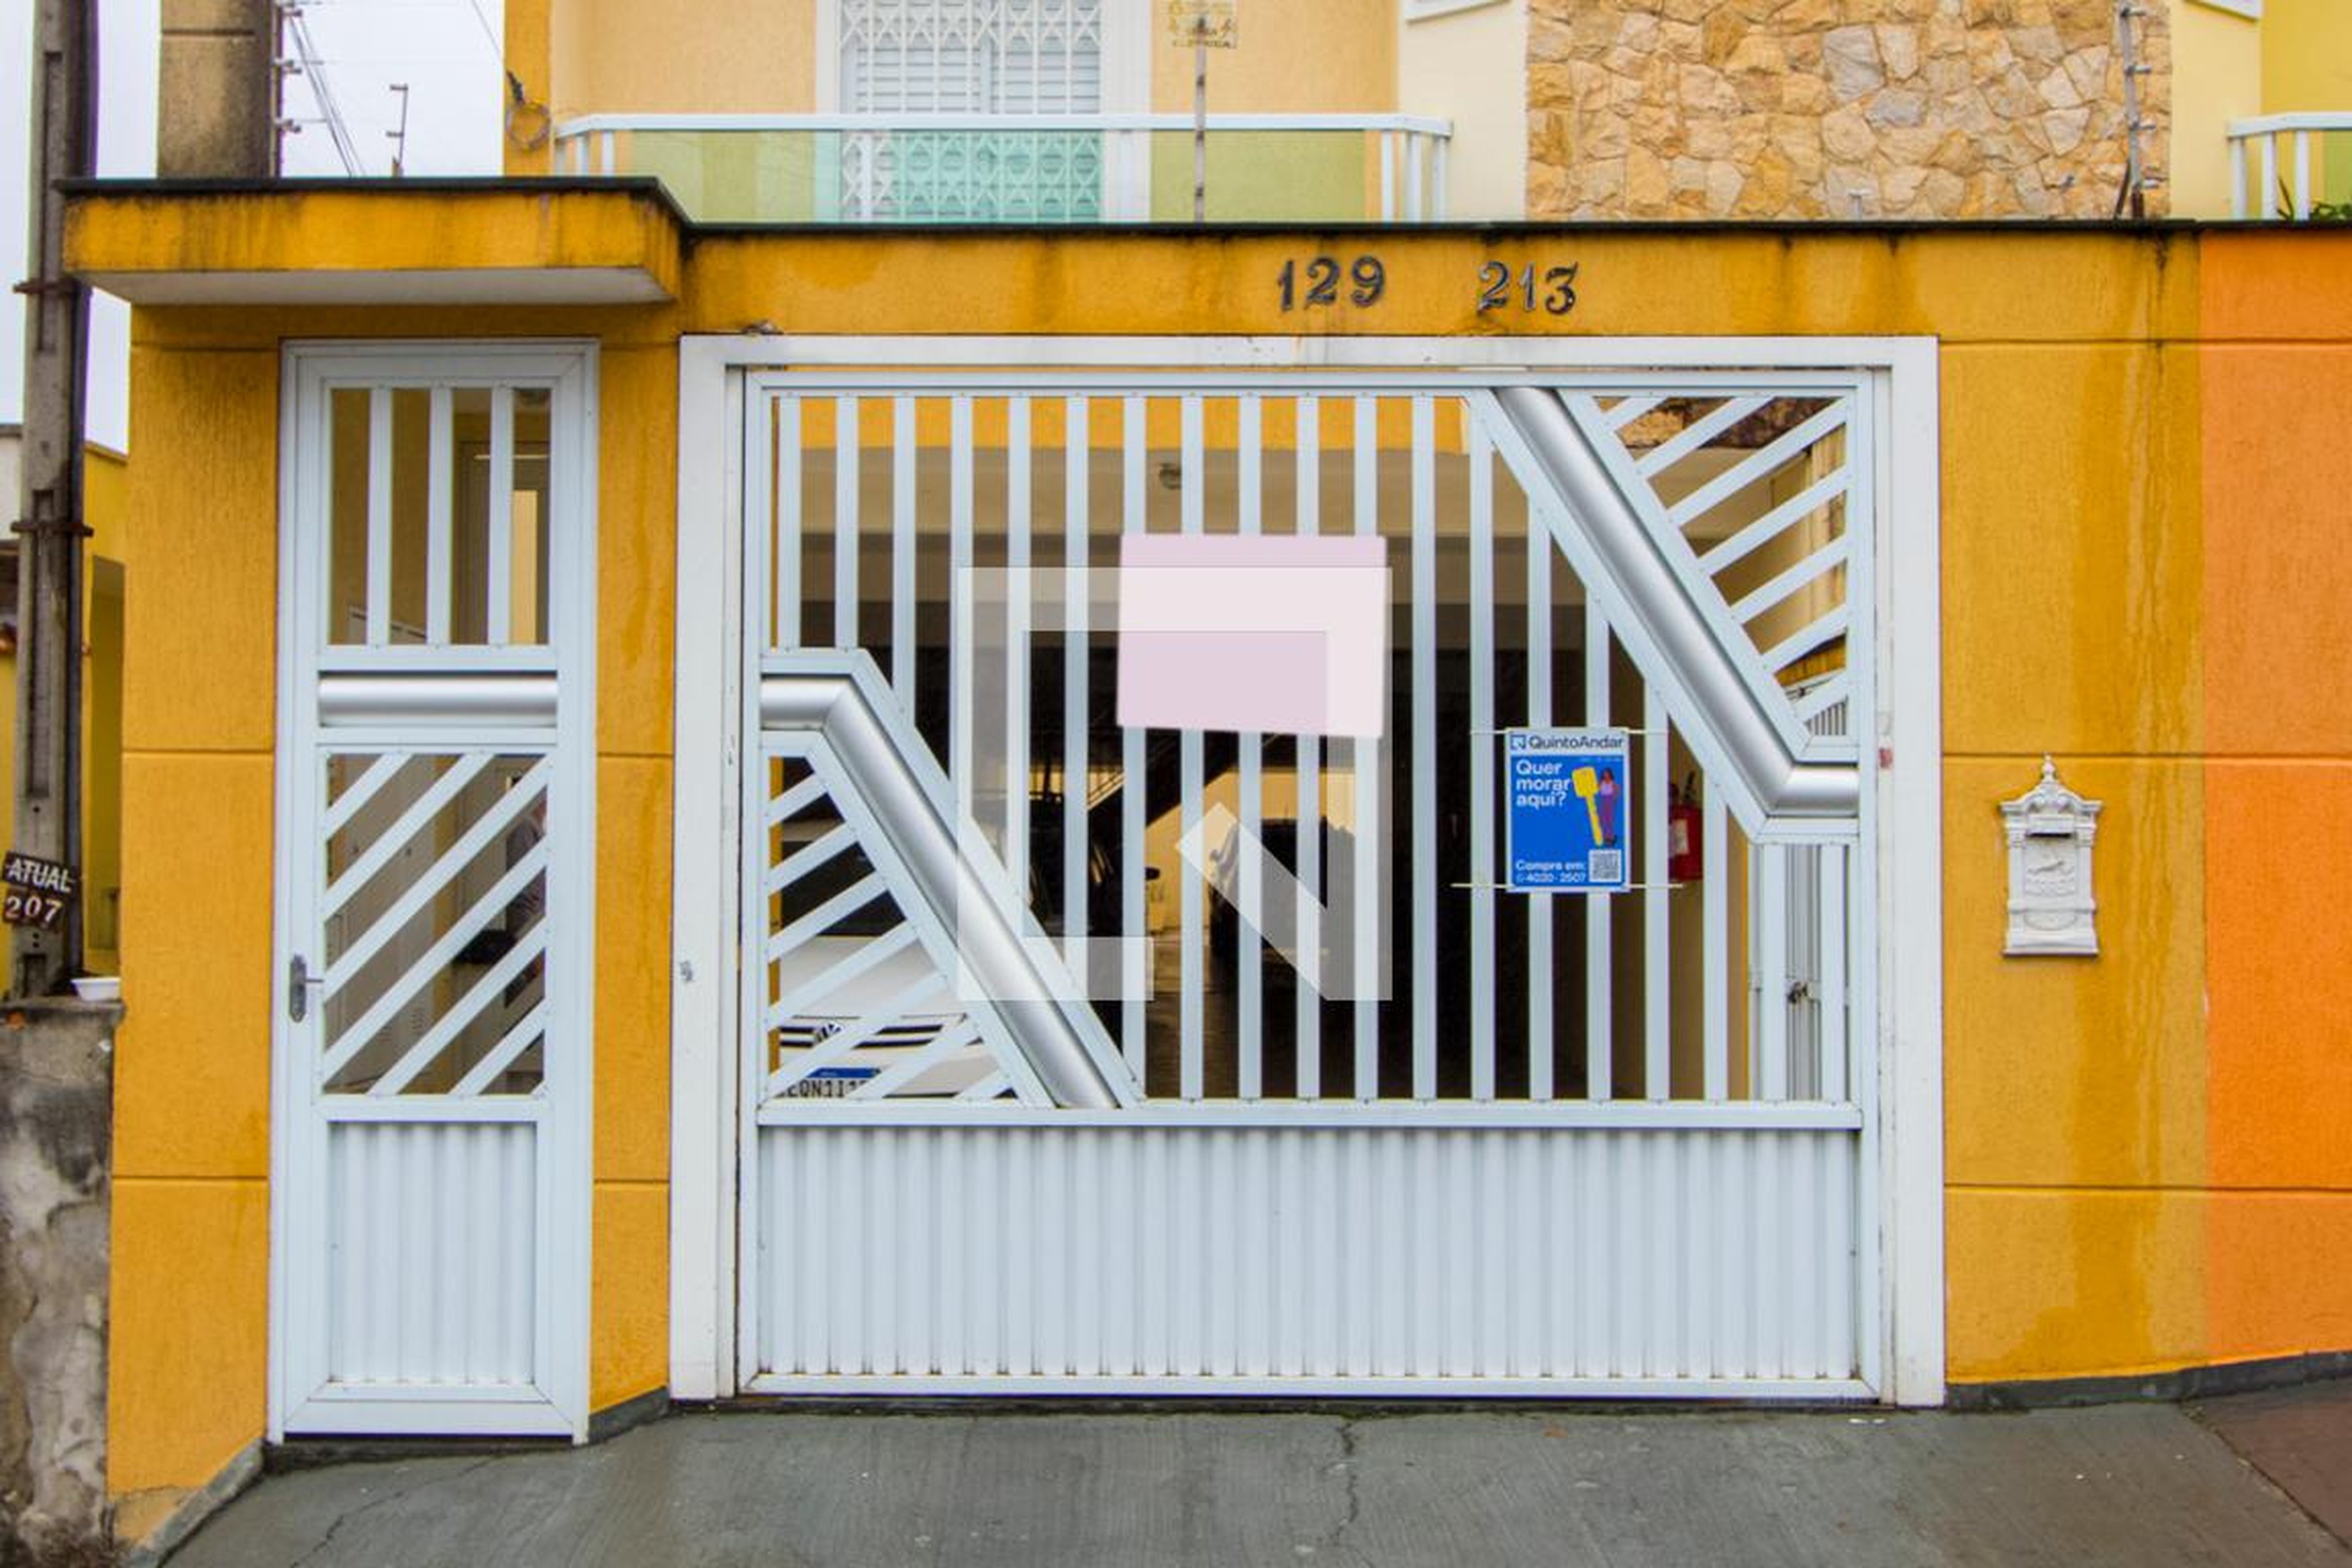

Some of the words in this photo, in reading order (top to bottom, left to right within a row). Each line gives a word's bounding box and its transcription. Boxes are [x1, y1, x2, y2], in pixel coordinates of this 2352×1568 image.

[1278, 256, 1385, 311] 129
[1477, 261, 1578, 315] 213
[1529, 735, 1623, 750] QuintoAndar
[1516, 759, 1562, 776] Quer
[1516, 777, 1571, 791] morar
[1516, 791, 1567, 810] aqui?
[7, 858, 72, 894] ATUAL
[5, 895, 62, 923] 207
